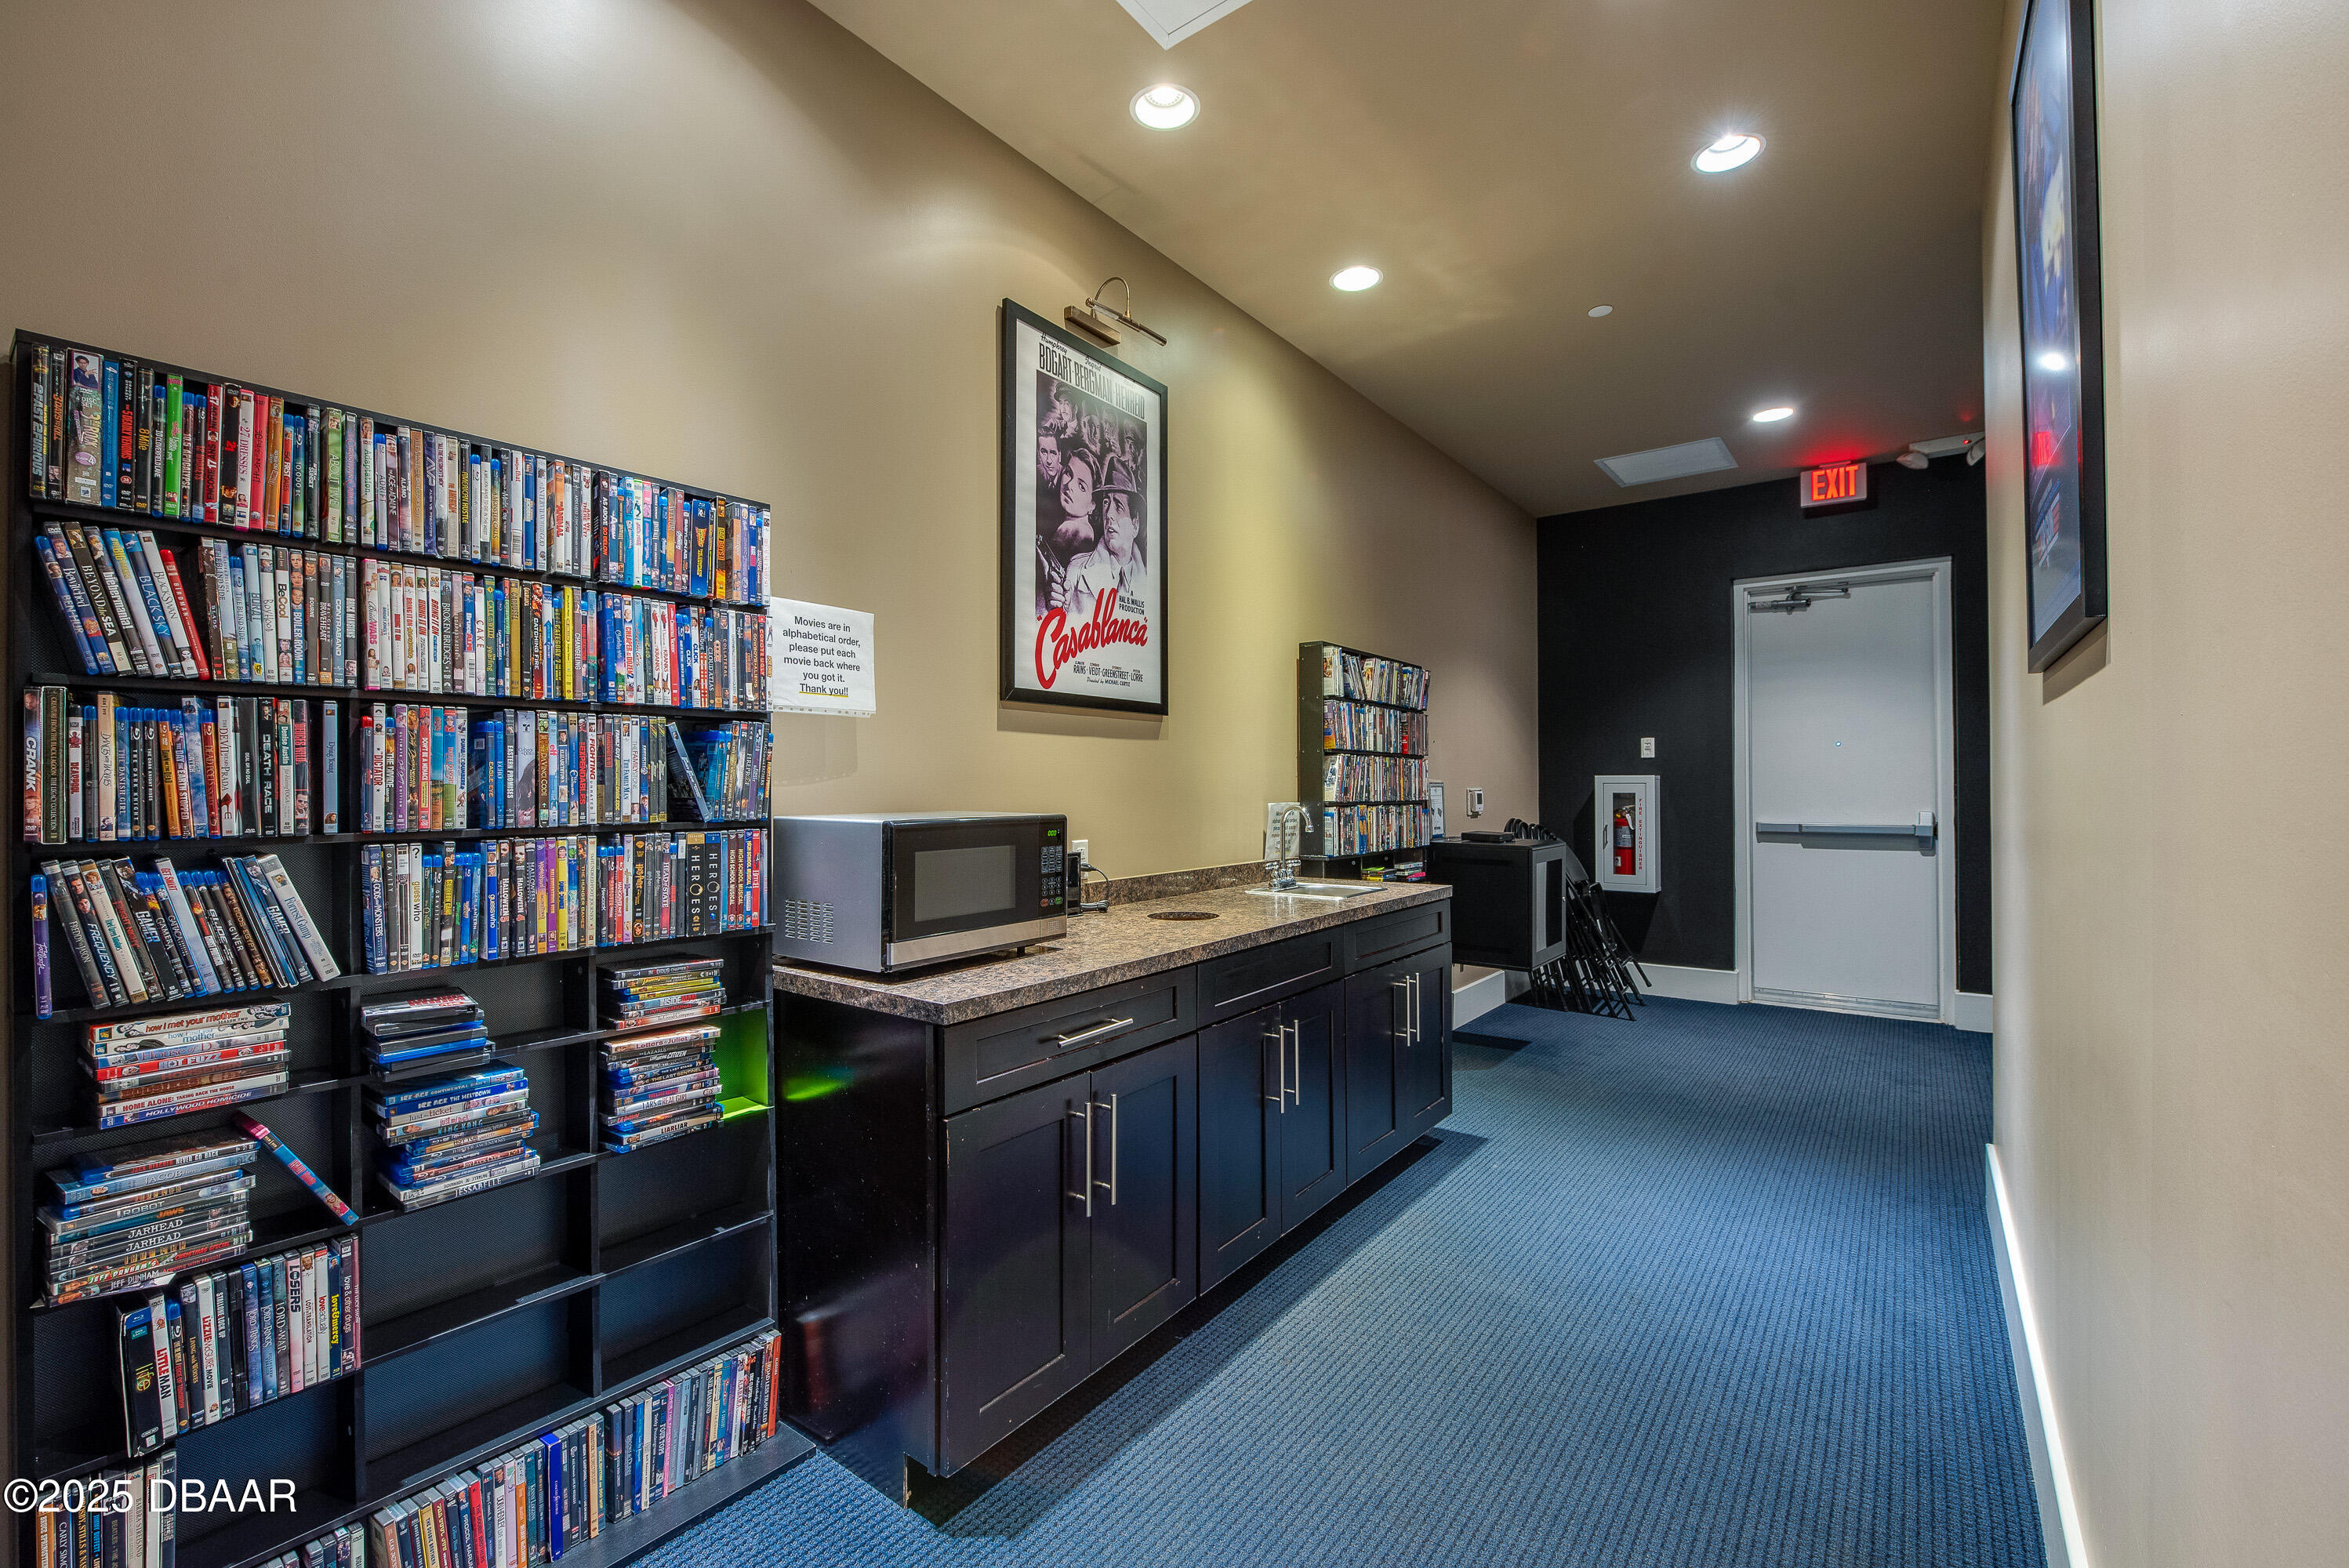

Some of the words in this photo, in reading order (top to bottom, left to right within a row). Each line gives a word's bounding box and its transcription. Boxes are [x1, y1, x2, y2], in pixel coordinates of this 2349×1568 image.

[1040, 332, 1068, 354] Humphrey
[1039, 343, 1072, 383] BOGART
[1074, 361, 1112, 403] BERGMAN
[122, 416, 133, 435] DEADLY
[240, 426, 250, 437] 27
[122, 436, 133, 459] VENOMS
[138, 434, 149, 451] Mile
[225, 441, 236, 452] 21
[239, 440, 249, 474] DRESSES
[182, 449, 191, 489] APOCALYPSE
[330, 454, 339, 484] ABOUT
[1812, 464, 1859, 501] EXIT
[330, 487, 339, 505] TIME
[602, 497, 608, 507] AS
[602, 527, 608, 536] SO
[64, 568, 89, 608] Bewitched
[82, 565, 106, 607] BEYOND
[101, 616, 116, 637] SEA
[103, 572, 133, 630] biebermania!
[139, 575, 159, 613] BLACK
[152, 615, 170, 637] SKY
[347, 597, 355, 612] BRICK
[1118, 596, 1127, 604] HAL
[1131, 598, 1145, 608] WALLIS
[1119, 603, 1145, 615] PRODUCTION
[63, 595, 83, 633] BEN-HUR
[794, 616, 826, 628] Movies
[828, 622, 841, 630] are
[843, 623, 850, 632] in
[347, 613, 355, 638] MANSIONS
[369, 621, 377, 644] WARS
[443, 633, 452, 665] BRIDGES
[782, 629, 836, 643] alphabetical
[838, 637, 861, 648] order,
[789, 643, 818, 653] please
[821, 647, 834, 655] put
[837, 649, 855, 658] each
[784, 656, 811, 666] movie
[814, 659, 834, 668] back
[821, 673, 835, 682] got
[1073, 665, 1086, 674] RAINS
[1102, 667, 1128, 680] GREENSTREET
[1131, 672, 1143, 682] LORRE
[800, 683, 826, 693] Thank
[263, 734, 272, 776] DEATH
[326, 742, 335, 757] Dying
[25, 736, 37, 792] CRANK
[374, 754, 383, 786] DICTATOR
[161, 868, 172, 877] GET
[164, 877, 178, 891] SMART
[135, 911, 160, 943] GAMER
[267, 905, 290, 935] GAMER
[284, 897, 303, 920] Forrest
[296, 920, 312, 939] Gump
[228, 926, 244, 951] GIVER
[36, 942, 48, 975] Footloose
[87, 924, 117, 981] FREQUENCY
[168, 1019, 184, 1028] met
[185, 1017, 205, 1029] your
[206, 1011, 241, 1023] mother
[146, 1099, 205, 1116] HOLLYWOOD
[207, 1091, 252, 1105] HOMICIDE
[147, 1098, 174, 1109] ALONE:
[129, 1219, 183, 1239] JARHEAD
[126, 1232, 181, 1251] JARHEAD
[343, 1314, 352, 1333] drugs
[134, 1363, 154, 1392] life
